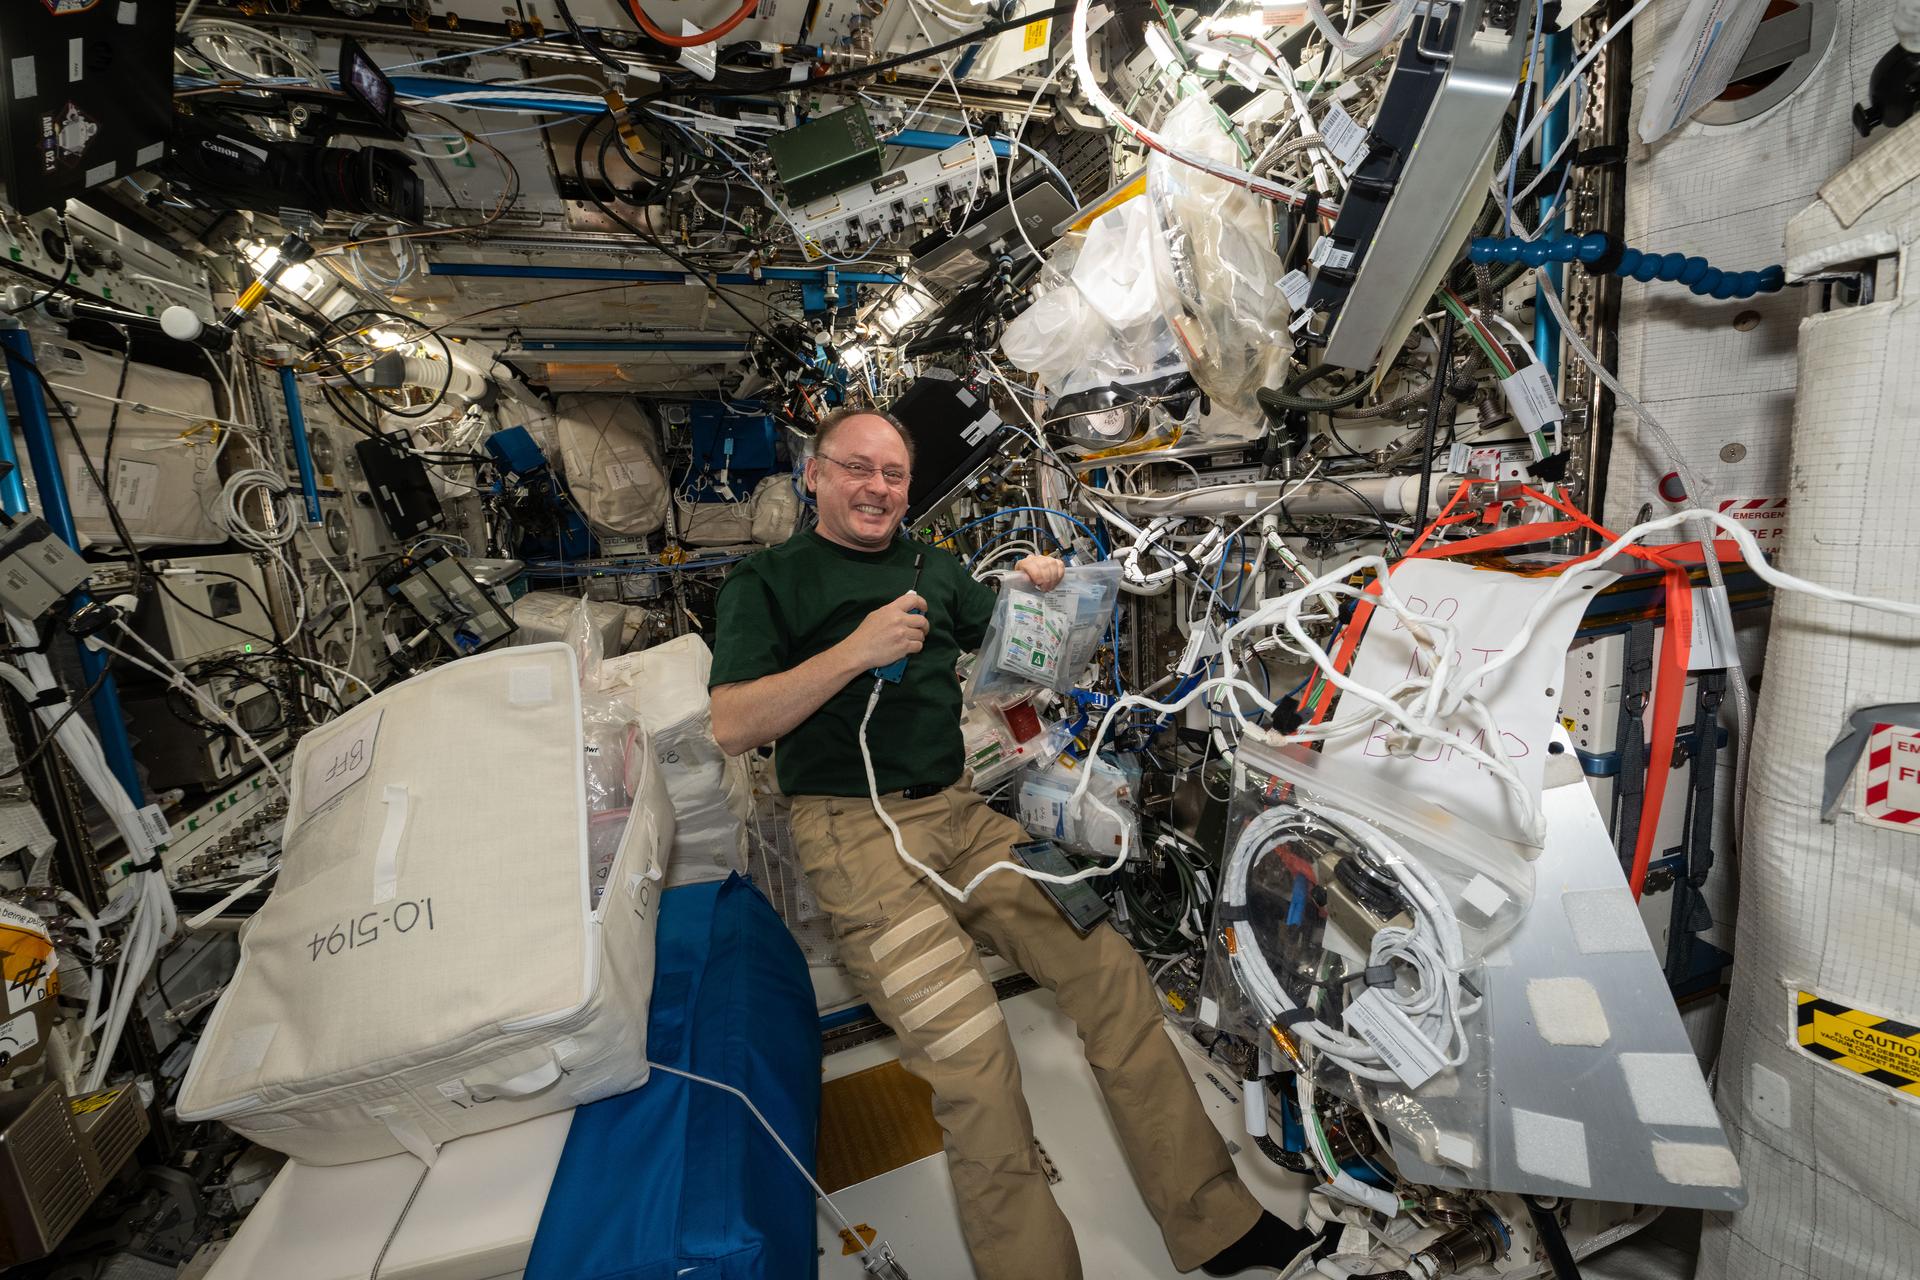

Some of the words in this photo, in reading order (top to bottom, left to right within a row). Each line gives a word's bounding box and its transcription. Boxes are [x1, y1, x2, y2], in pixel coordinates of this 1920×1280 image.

[42, 116, 53, 138] AMS
[201, 140, 239, 159] Canon
[324, 738, 364, 783] BFF
[2, 908, 26, 924] being
[306, 897, 434, 962] 1.0-5194
[37, 981, 59, 1001] DLR
[1820, 1030, 1853, 1048] VACUUM
[1855, 1043, 1896, 1063] CLEANER
[1834, 1031, 1875, 1051] FLOATING
[1876, 1046, 1909, 1062] DEBRIS
[1852, 1028, 1920, 1059] CAUTIO
[1847, 1047, 1887, 1068] BLANKET
